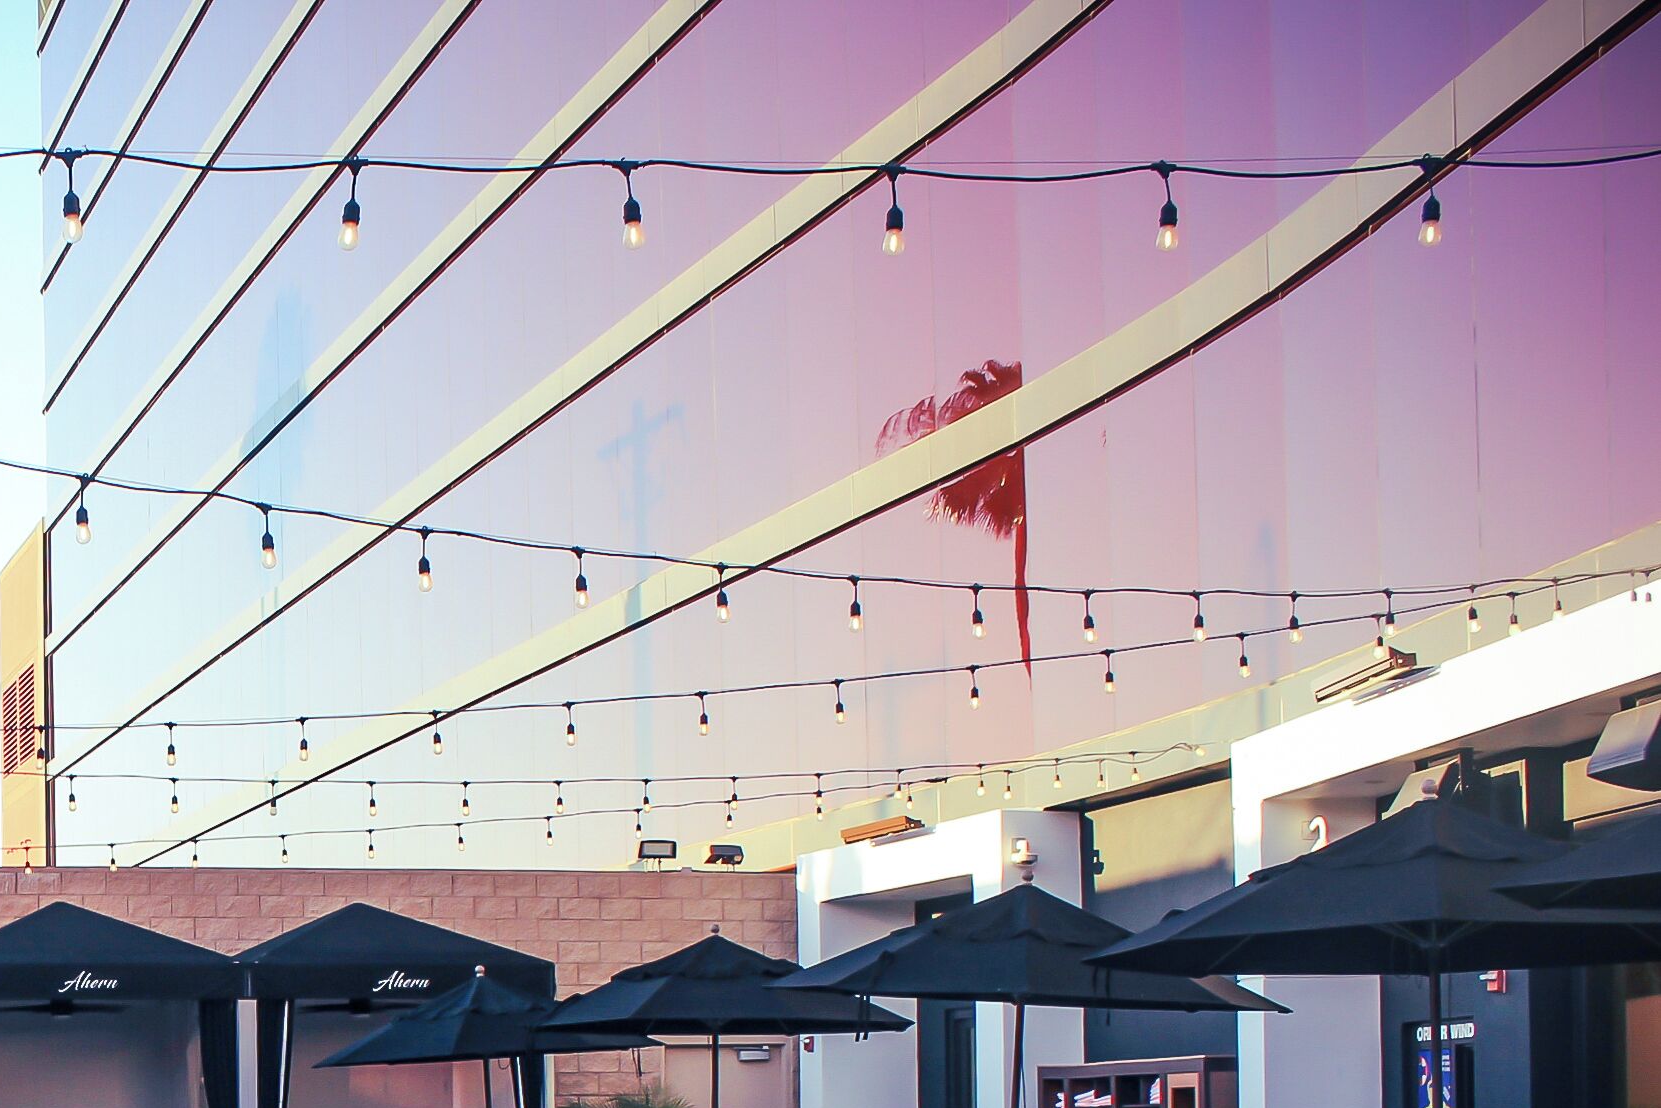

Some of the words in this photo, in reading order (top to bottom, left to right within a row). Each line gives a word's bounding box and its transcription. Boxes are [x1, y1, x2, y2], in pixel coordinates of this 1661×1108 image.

[58, 970, 119, 993] Ahern
[372, 970, 430, 992] Ahern
[1416, 1024, 1448, 1042] ORR
